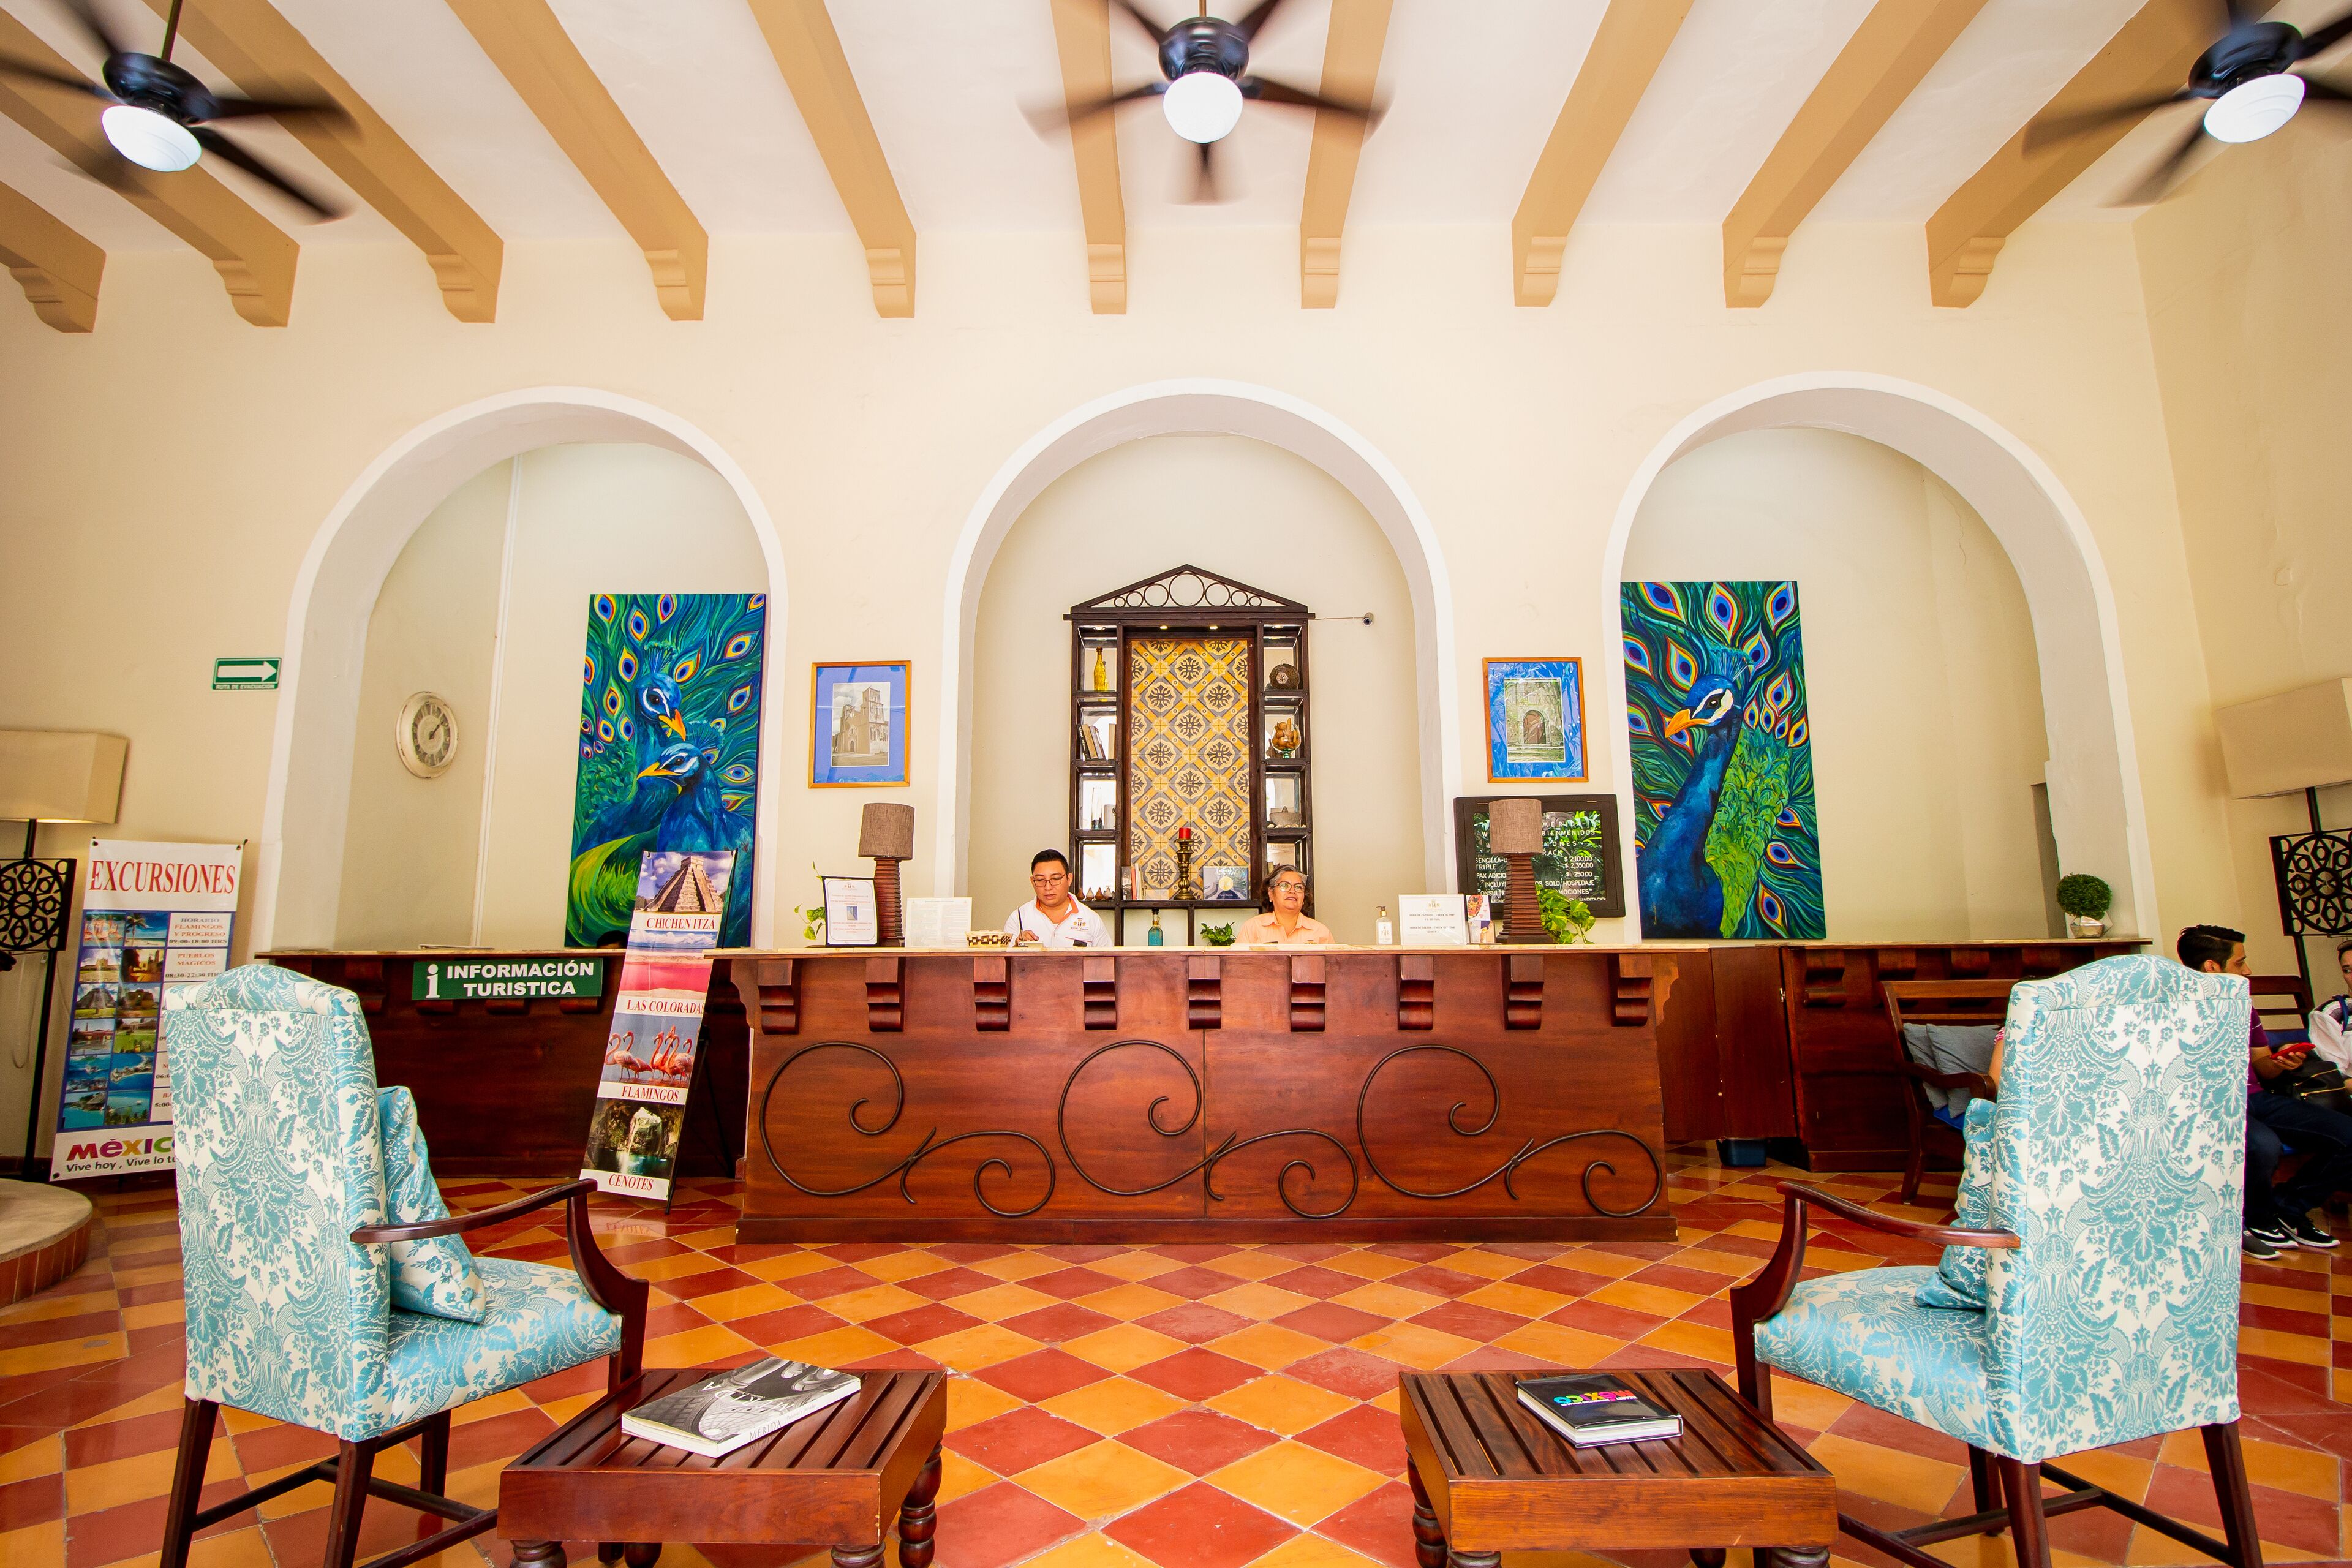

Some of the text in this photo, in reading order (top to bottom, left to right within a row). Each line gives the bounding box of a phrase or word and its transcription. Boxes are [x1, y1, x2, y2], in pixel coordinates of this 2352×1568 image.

[89, 860, 236, 894] EXCURSIONES
[646, 915, 715, 929] CHICHEN ITZÁ
[447, 960, 594, 979] INFORMACIÓN
[464, 981, 576, 997] TURISTICA
[627, 999, 647, 1011] LAS
[621, 1085, 679, 1102] FLAMINGOS
[66, 1163, 91, 1172] Vive
[95, 1161, 117, 1170] hoy
[126, 1157, 149, 1167] Vive
[154, 1156, 164, 1164] lo
[608, 1174, 654, 1191] CENOTES
